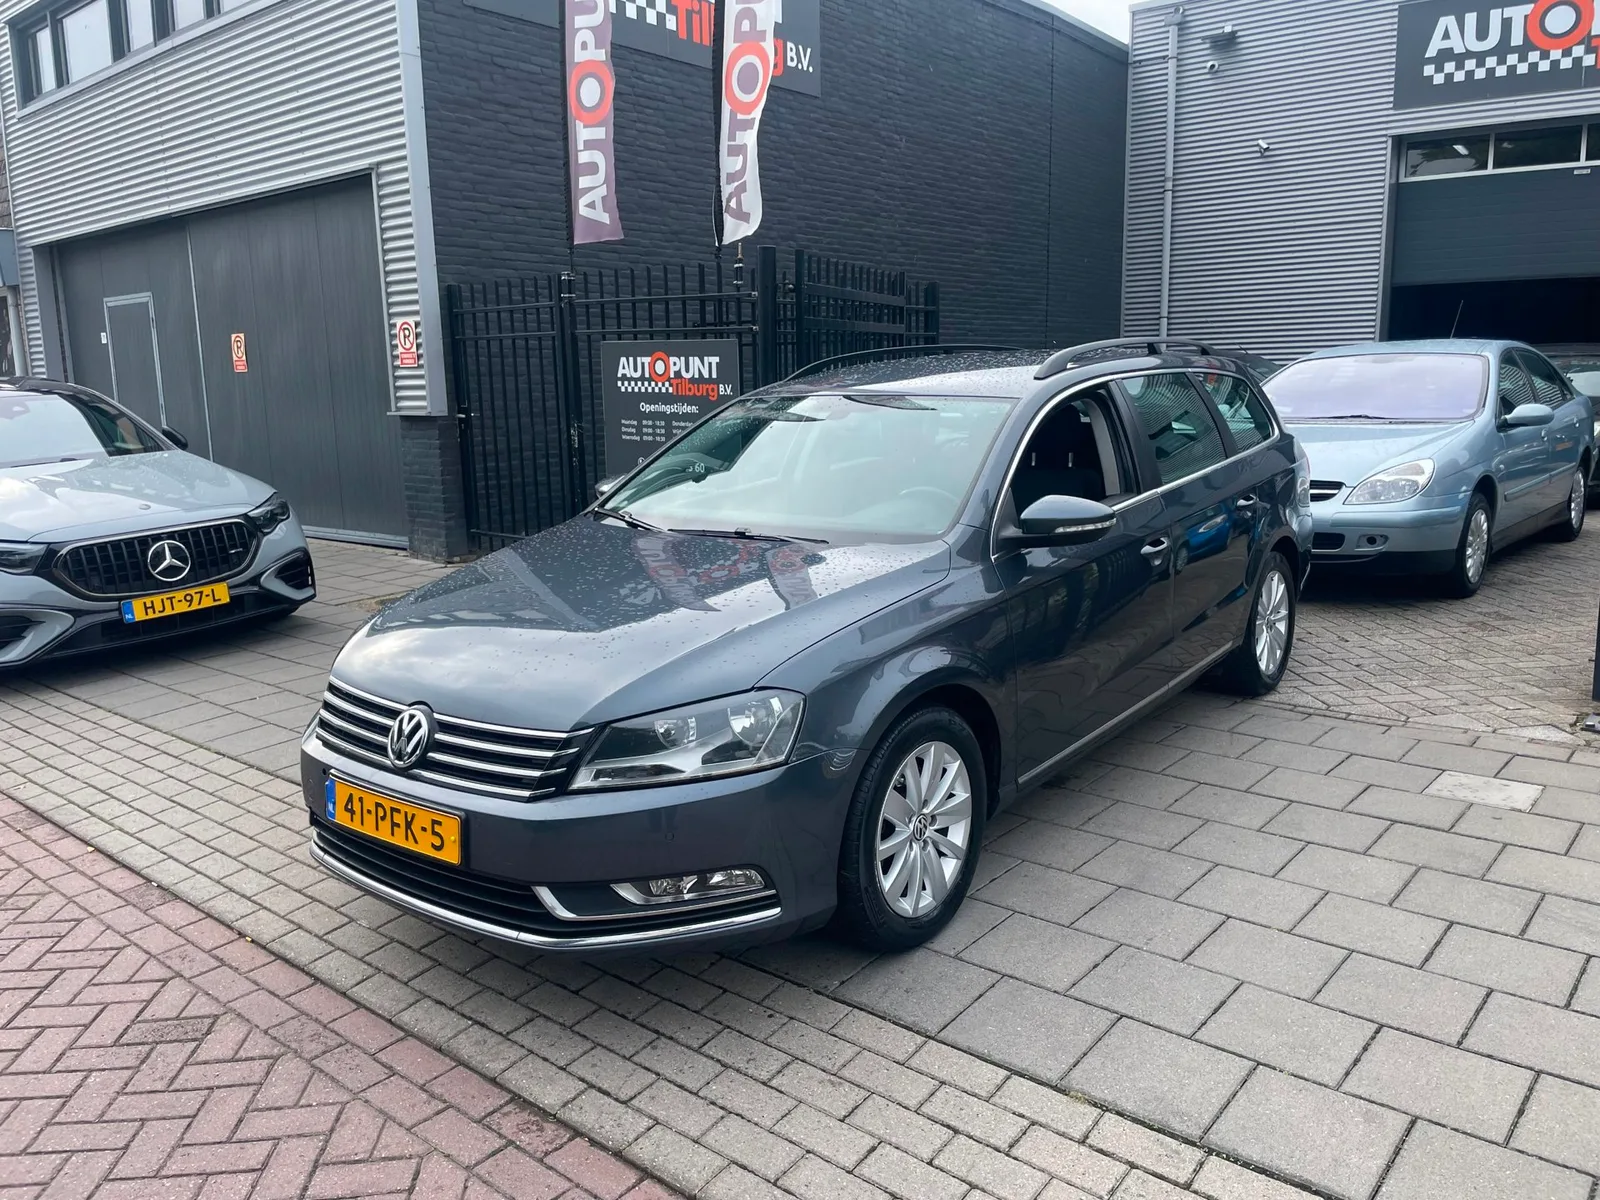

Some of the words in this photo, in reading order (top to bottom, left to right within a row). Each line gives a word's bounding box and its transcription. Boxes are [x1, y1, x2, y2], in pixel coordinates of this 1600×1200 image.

[1425, 0, 1600, 58] AUTO
[787, 41, 813, 73] B.V.
[725, 0, 769, 224] AUTOP
[617, 351, 719, 382] AUTOPUNT
[671, 379, 718, 401] Tilburg
[719, 384, 733, 395] B.V.
[640, 402, 699, 414] Openingstijden:
[143, 588, 221, 616] HJT-97-L
[344, 792, 445, 852] 41-PFK-5
